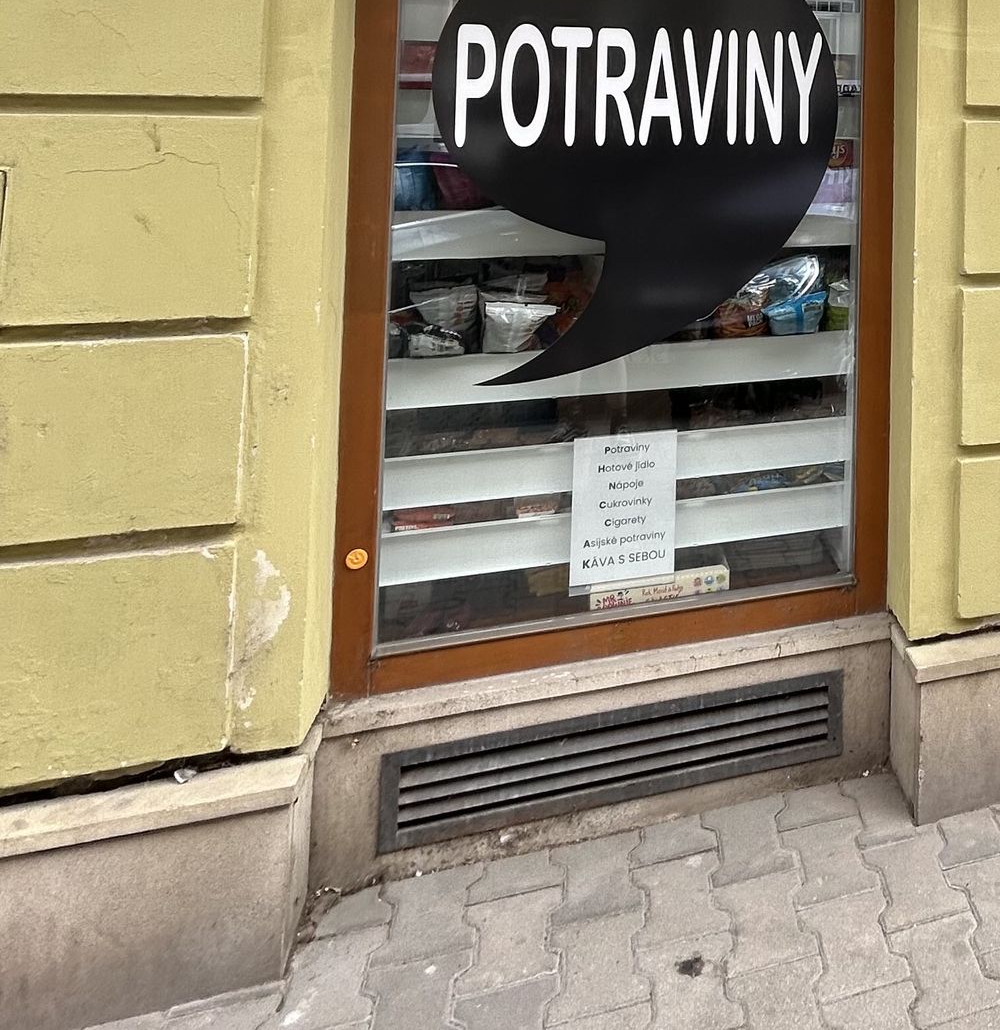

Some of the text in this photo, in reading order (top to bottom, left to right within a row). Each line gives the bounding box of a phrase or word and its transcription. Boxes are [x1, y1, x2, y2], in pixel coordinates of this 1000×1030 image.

[454, 23, 823, 147] POTRAVINY
[604, 443, 650, 454] Potraviny
[598, 463, 633, 473] Hotové
[608, 479, 644, 491] Nápoje
[599, 496, 652, 509] Cukrovinky
[604, 515, 646, 528] Cigarety
[583, 530, 666, 549] Asijské potraviny
[582, 549, 666, 569] KÁVA S SEBOU
